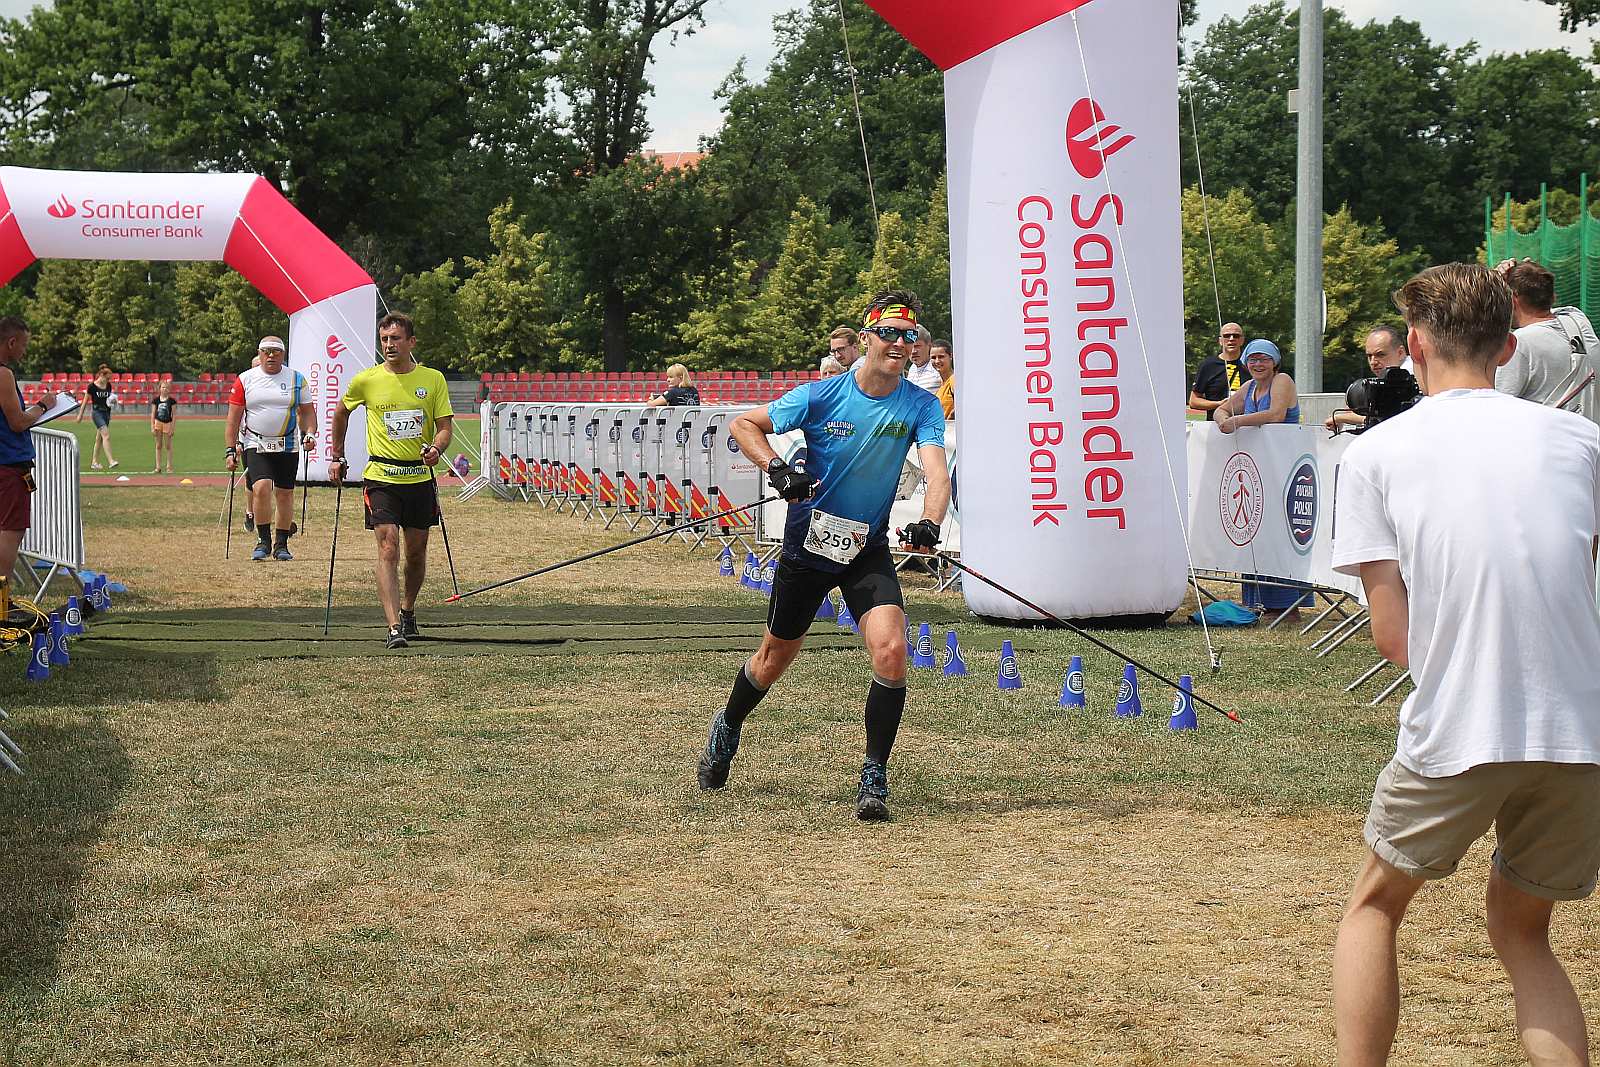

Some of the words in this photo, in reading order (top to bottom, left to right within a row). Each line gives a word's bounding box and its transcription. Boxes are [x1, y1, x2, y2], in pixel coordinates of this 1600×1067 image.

[81, 199, 205, 219] Santander
[82, 224, 161, 238] Consumer
[164, 225, 203, 238] Bank
[1017, 195, 1054, 413] Consumer
[1070, 193, 1134, 530] Santander
[396, 421, 416, 430] 272
[1028, 421, 1068, 528] Bank
[1294, 501, 1313, 515] POLSKI
[820, 530, 852, 551] 259
